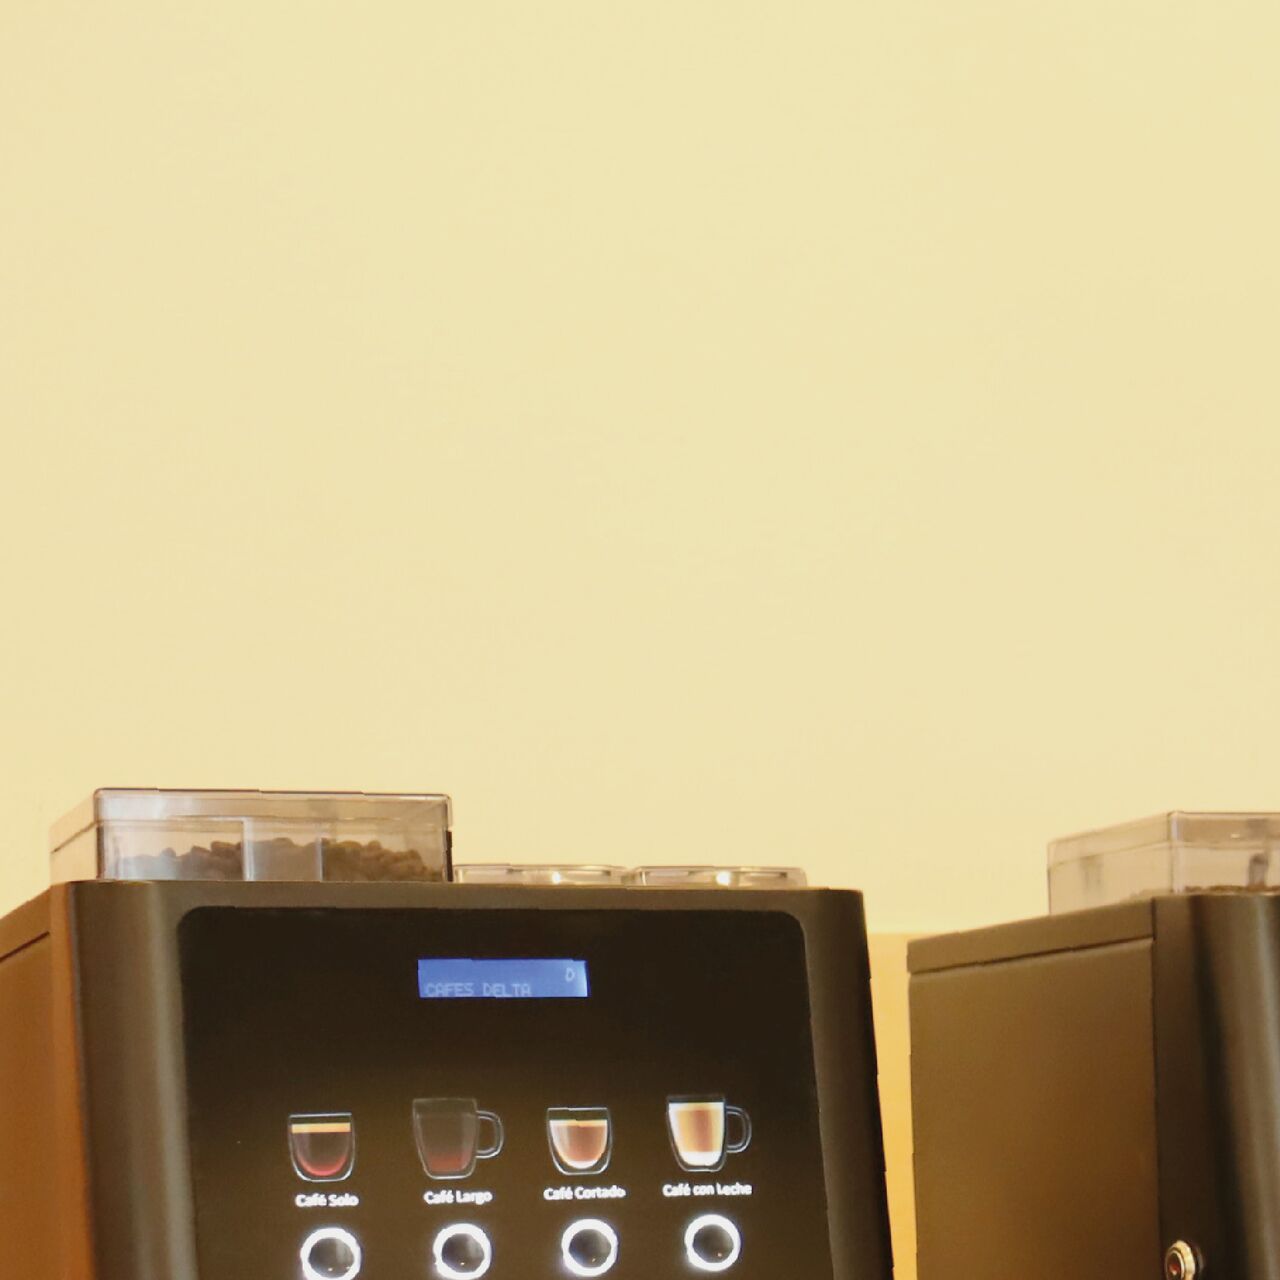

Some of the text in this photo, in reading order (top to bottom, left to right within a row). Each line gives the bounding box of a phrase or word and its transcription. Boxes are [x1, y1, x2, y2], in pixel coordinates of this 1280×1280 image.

[426, 983, 532, 997] CAFES DELTA
[543, 1184, 626, 1200] Café Cortado
[662, 1182, 752, 1197] Café con Leche
[295, 1193, 360, 1208] Café Solo
[423, 1189, 493, 1206] Café Largo
